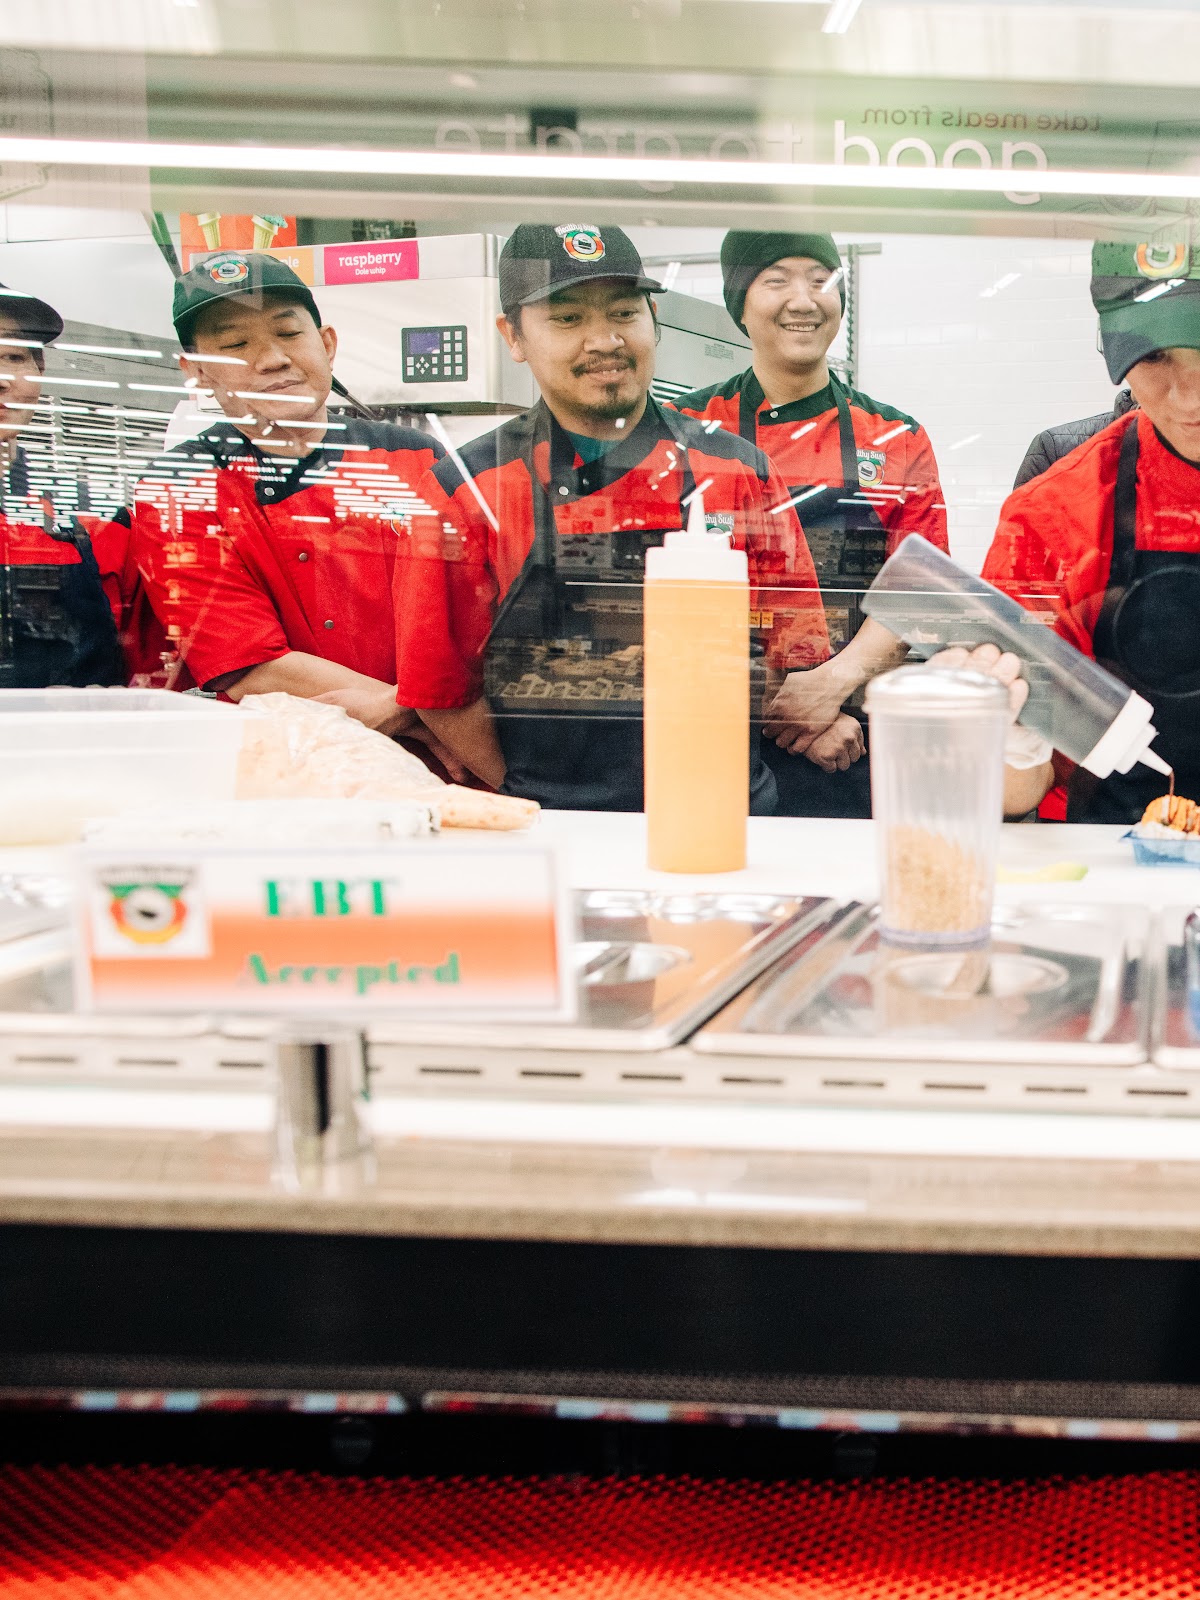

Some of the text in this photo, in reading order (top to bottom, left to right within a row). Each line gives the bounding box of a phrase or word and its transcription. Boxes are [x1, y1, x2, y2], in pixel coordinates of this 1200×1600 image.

[339, 252, 402, 269] raspberry
[355, 267, 386, 276] Dole whip
[261, 879, 402, 918] EBT
[239, 952, 461, 996] Accepted
